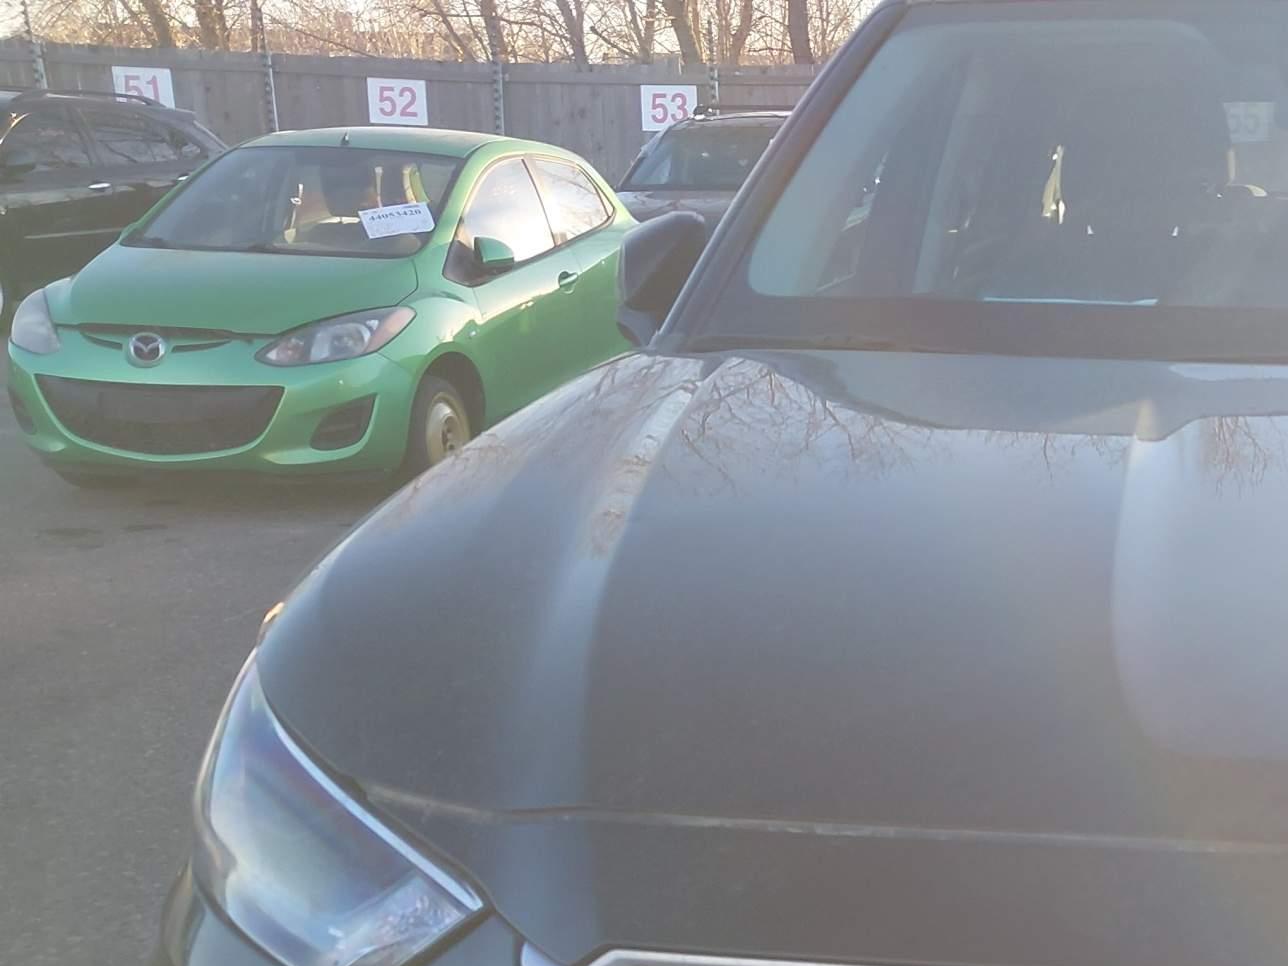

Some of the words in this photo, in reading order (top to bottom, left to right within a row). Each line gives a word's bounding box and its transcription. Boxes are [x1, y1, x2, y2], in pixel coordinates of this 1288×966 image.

[125, 75, 160, 102] 51
[379, 86, 417, 117] 52
[651, 93, 688, 123] 53
